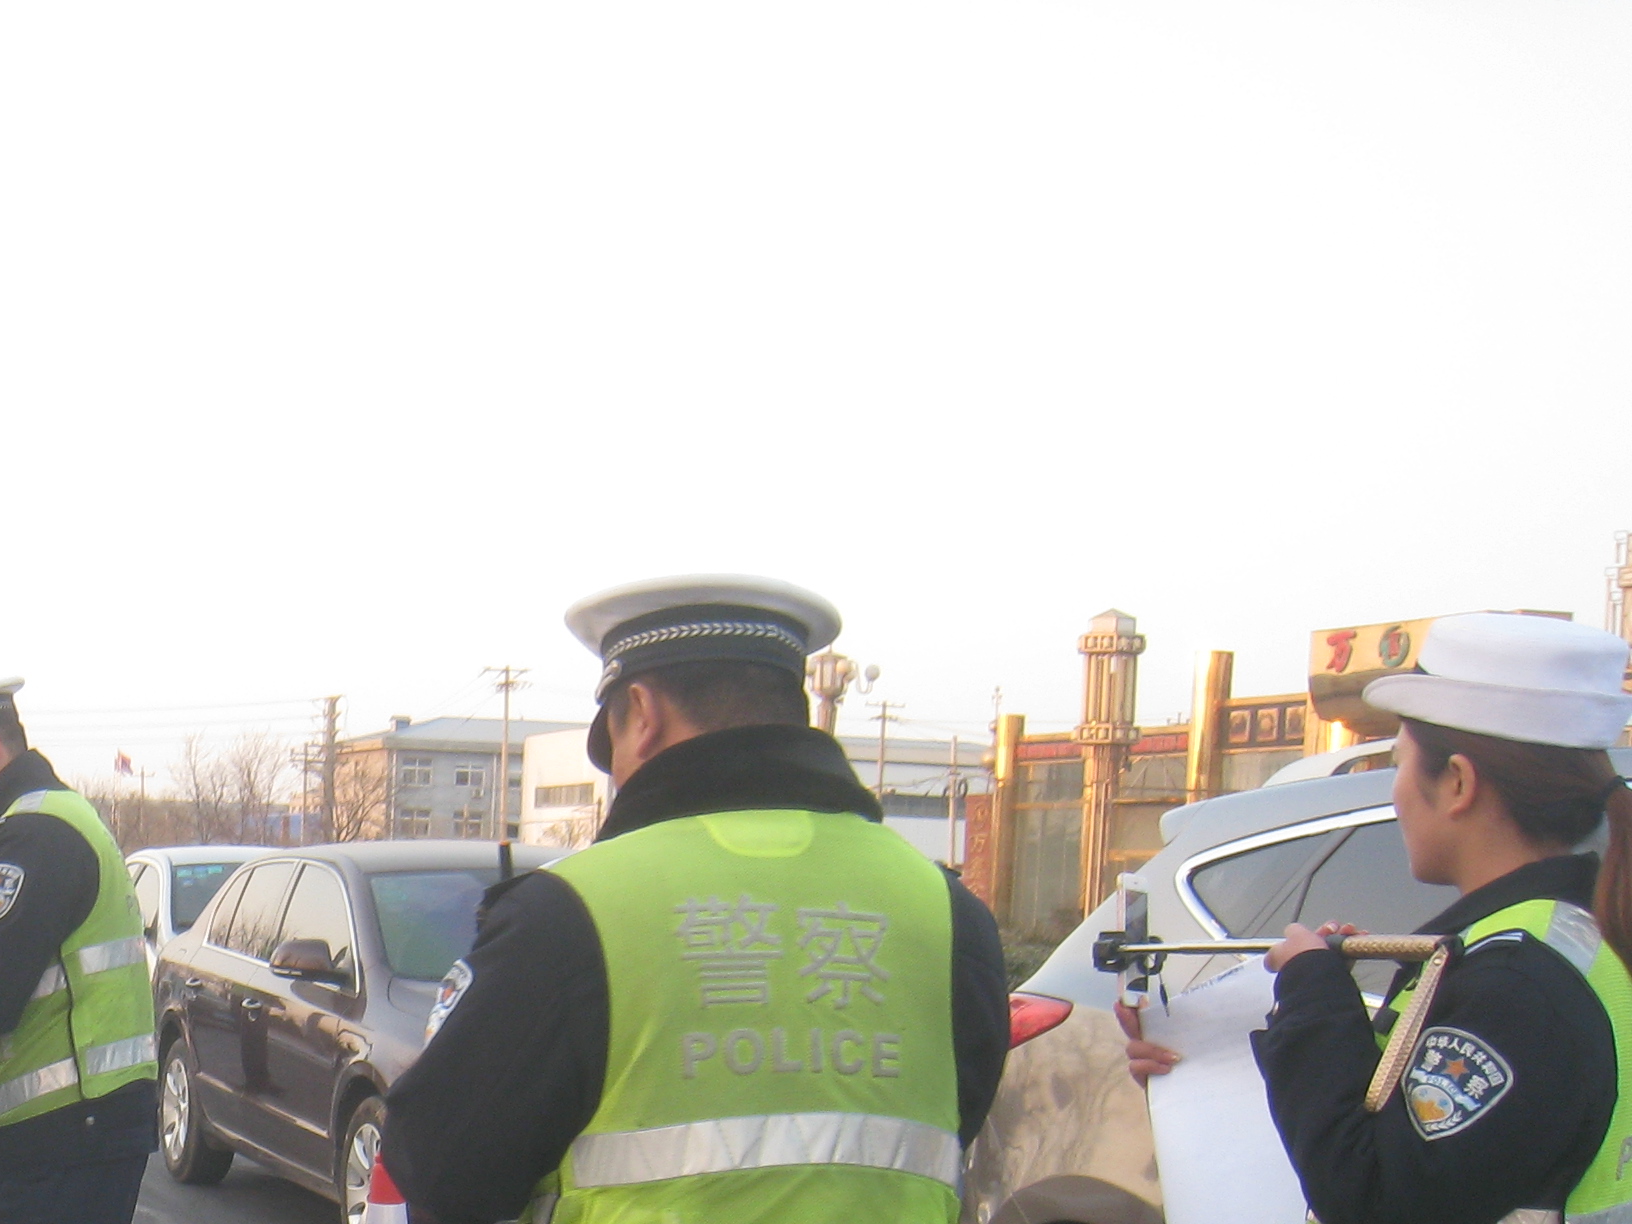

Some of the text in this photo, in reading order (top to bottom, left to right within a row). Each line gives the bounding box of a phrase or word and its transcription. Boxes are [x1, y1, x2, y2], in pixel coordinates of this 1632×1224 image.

[672, 893, 893, 1011] 警察
[680, 1027, 901, 1079] POLICE
[1424, 1035, 1505, 1087] 中华人民共和国
